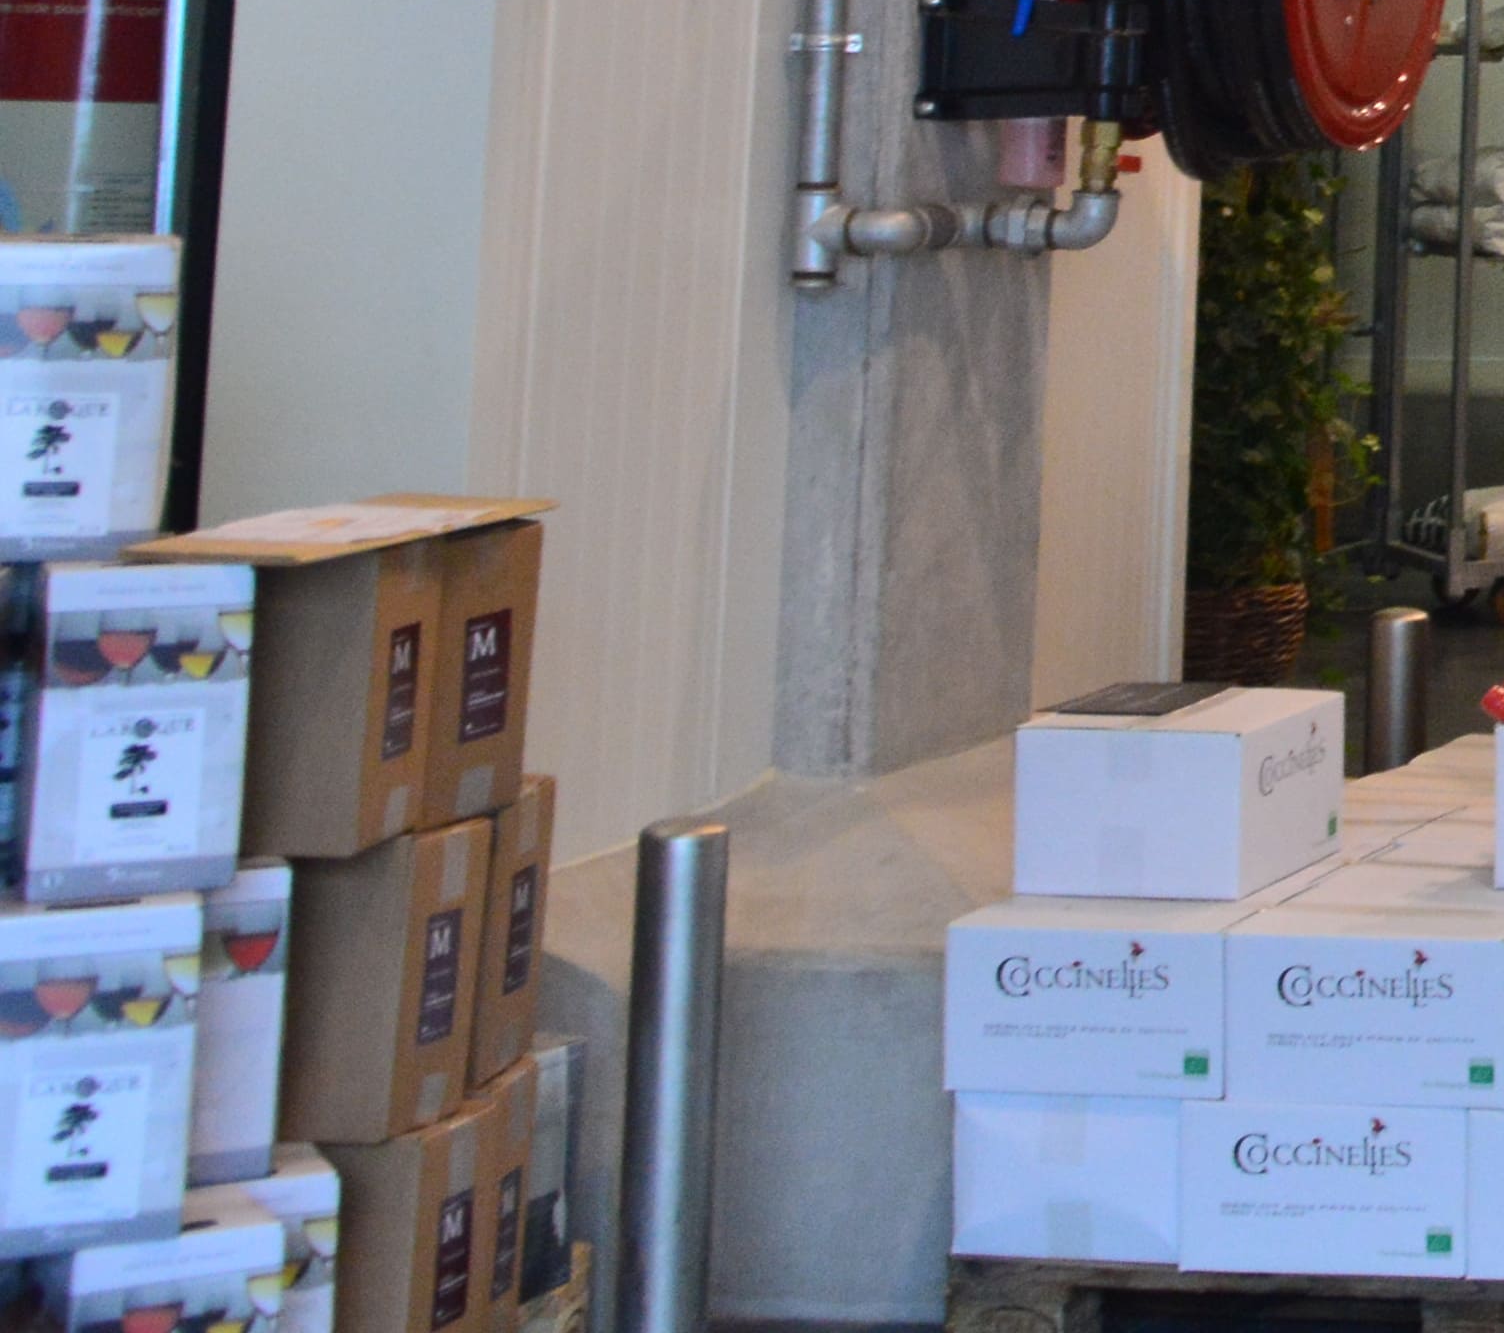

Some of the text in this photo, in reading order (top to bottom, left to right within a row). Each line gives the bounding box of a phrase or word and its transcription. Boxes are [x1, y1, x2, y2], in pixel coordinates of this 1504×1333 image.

[391, 640, 411, 675] M
[470, 626, 497, 661] M
[429, 924, 451, 960] M
